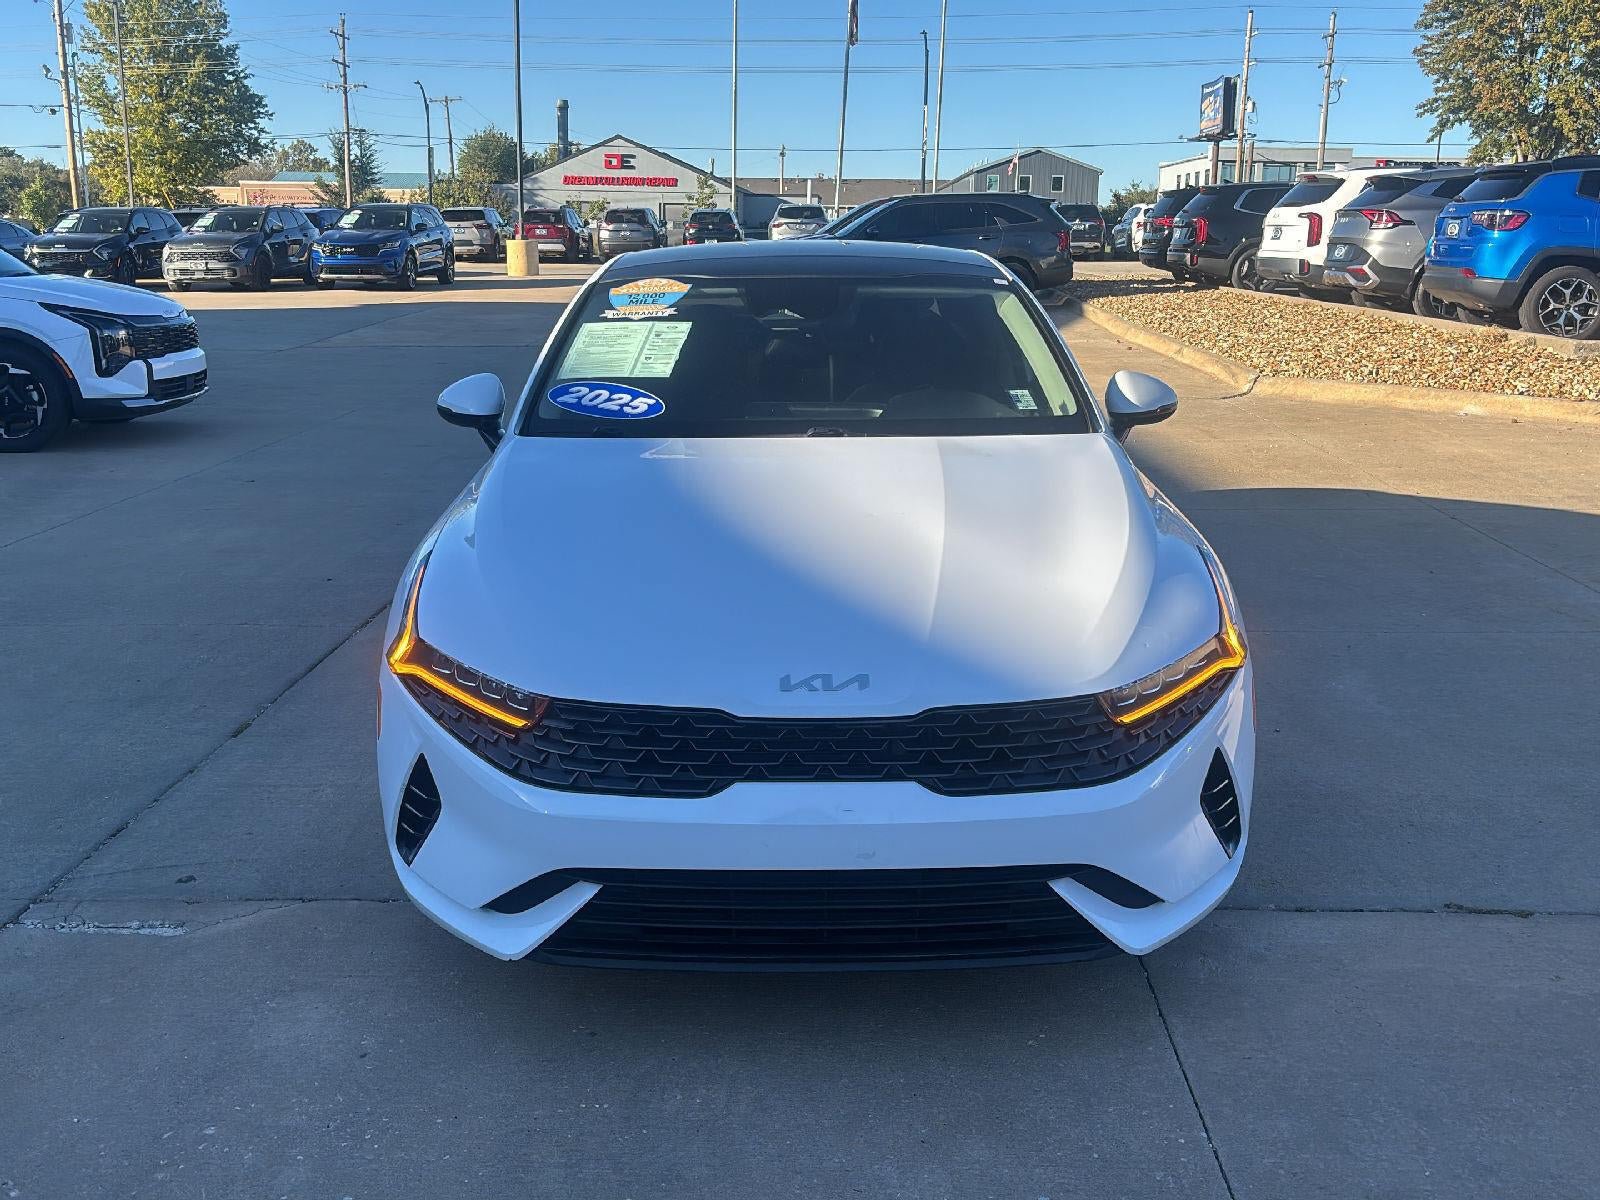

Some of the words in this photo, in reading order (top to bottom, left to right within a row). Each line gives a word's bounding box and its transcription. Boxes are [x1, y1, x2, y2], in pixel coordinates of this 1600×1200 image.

[562, 175, 597, 185] DREAM
[598, 175, 645, 186] COLLISION
[645, 176, 678, 187] REPAIR
[557, 386, 656, 414] 2025
[779, 673, 870, 692] KIA
